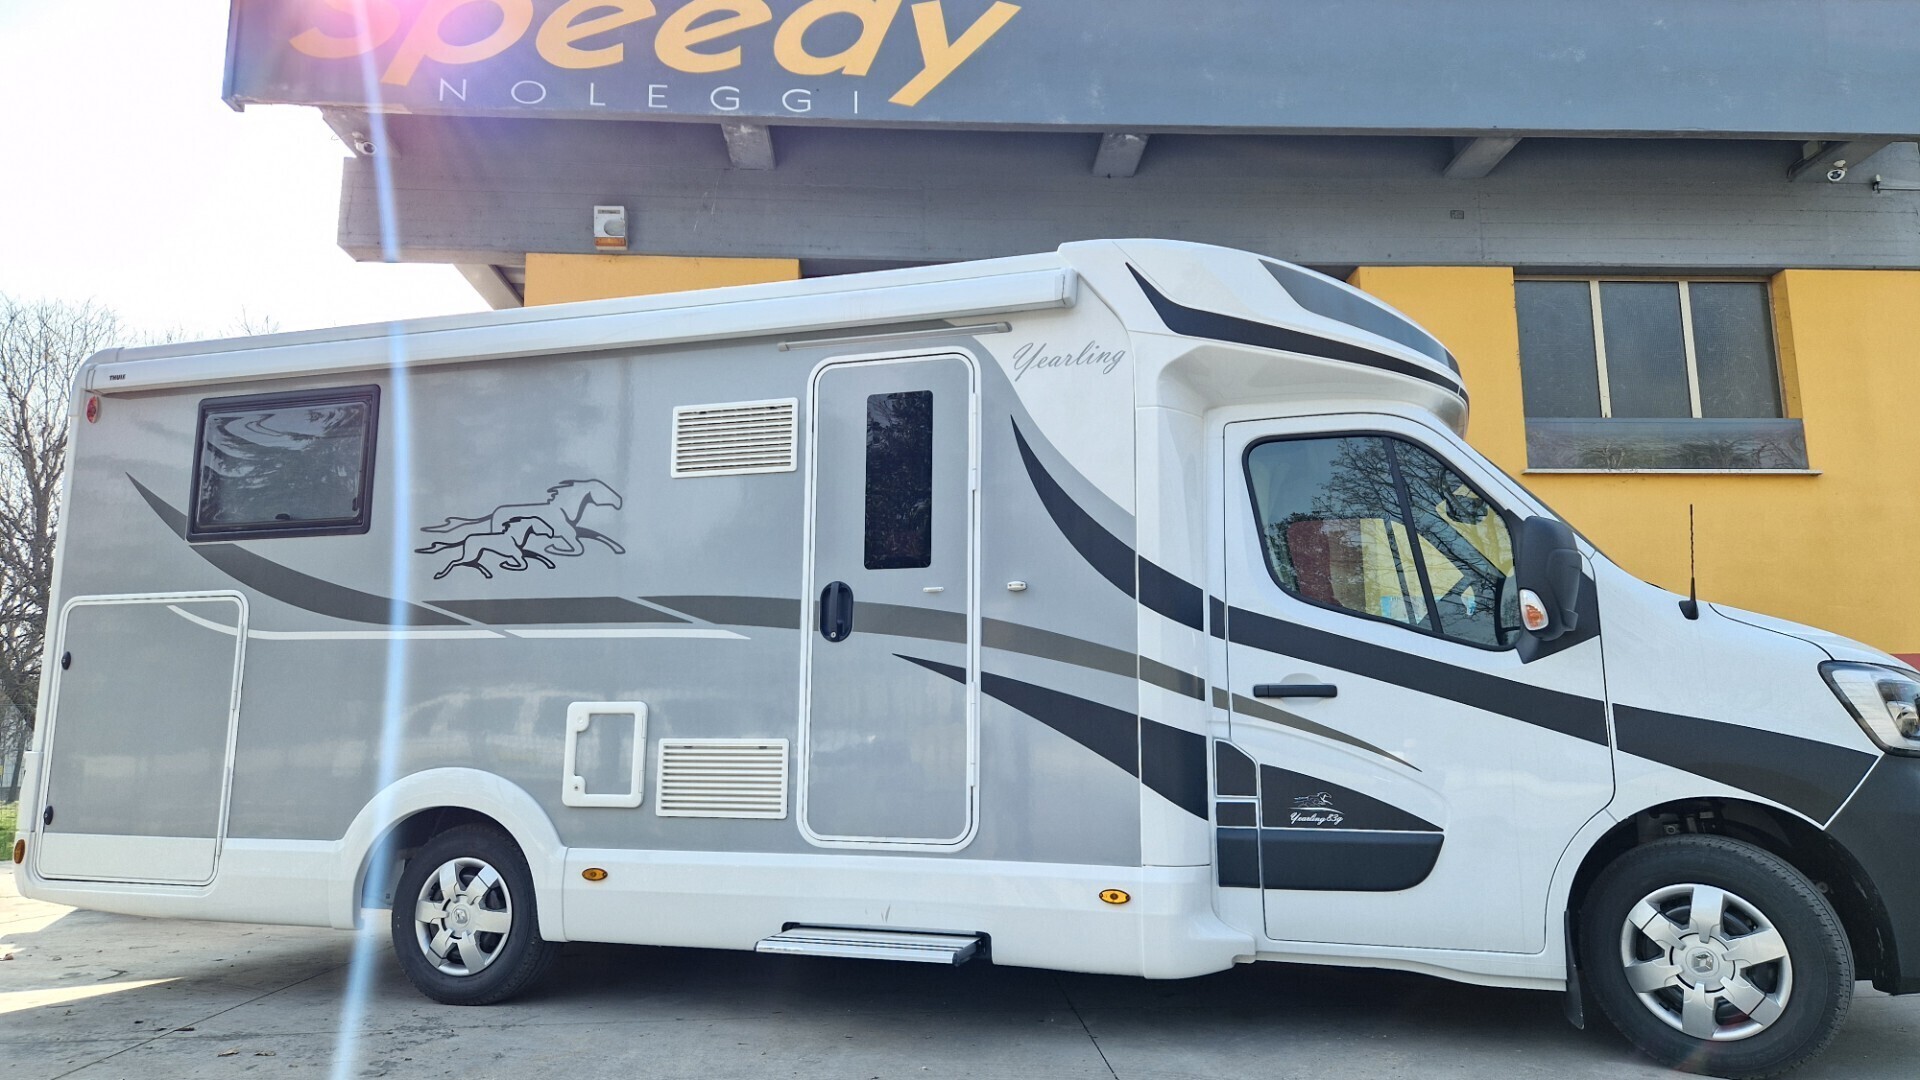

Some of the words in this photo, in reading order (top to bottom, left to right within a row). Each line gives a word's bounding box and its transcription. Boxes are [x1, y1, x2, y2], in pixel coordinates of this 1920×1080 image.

[439, 78, 858, 114] NOLEGGI
[1013, 340, 1126, 382] Yearling
[1290, 812, 1326, 825] Yearling
